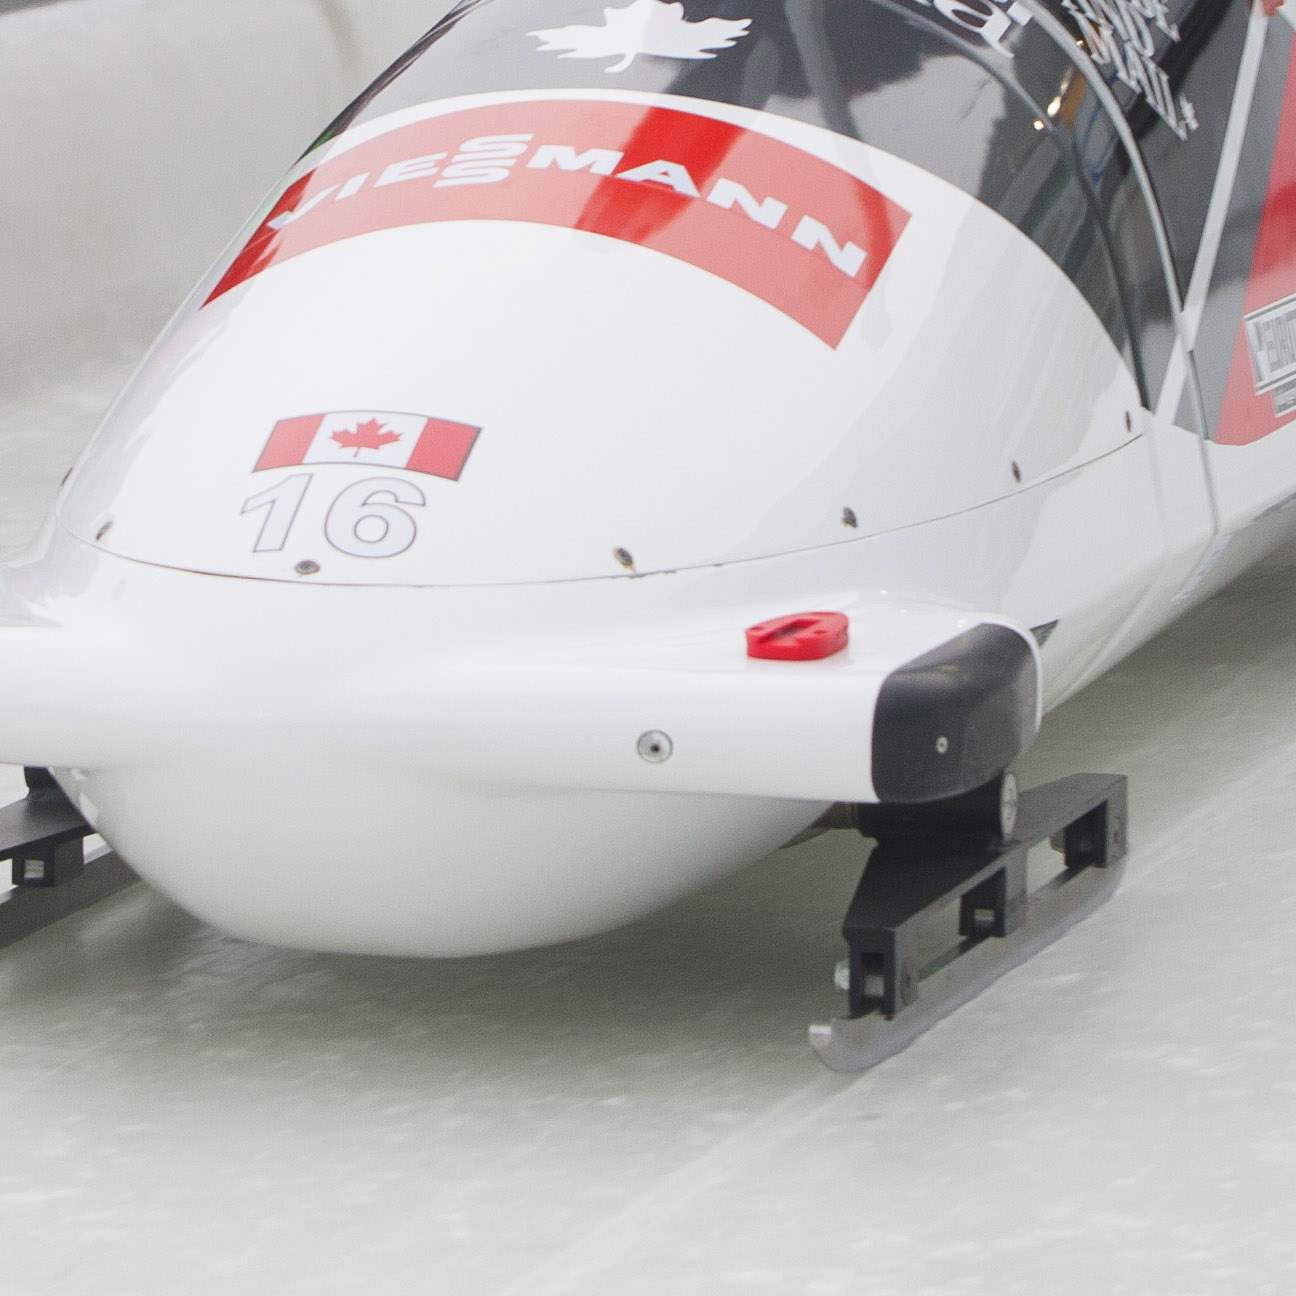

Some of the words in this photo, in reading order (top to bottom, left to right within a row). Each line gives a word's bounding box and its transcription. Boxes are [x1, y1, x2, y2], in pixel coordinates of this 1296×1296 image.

[1066, 8, 1189, 142] MAIL
[265, 133, 868, 279] VIESSMANN
[239, 472, 427, 560] 16
